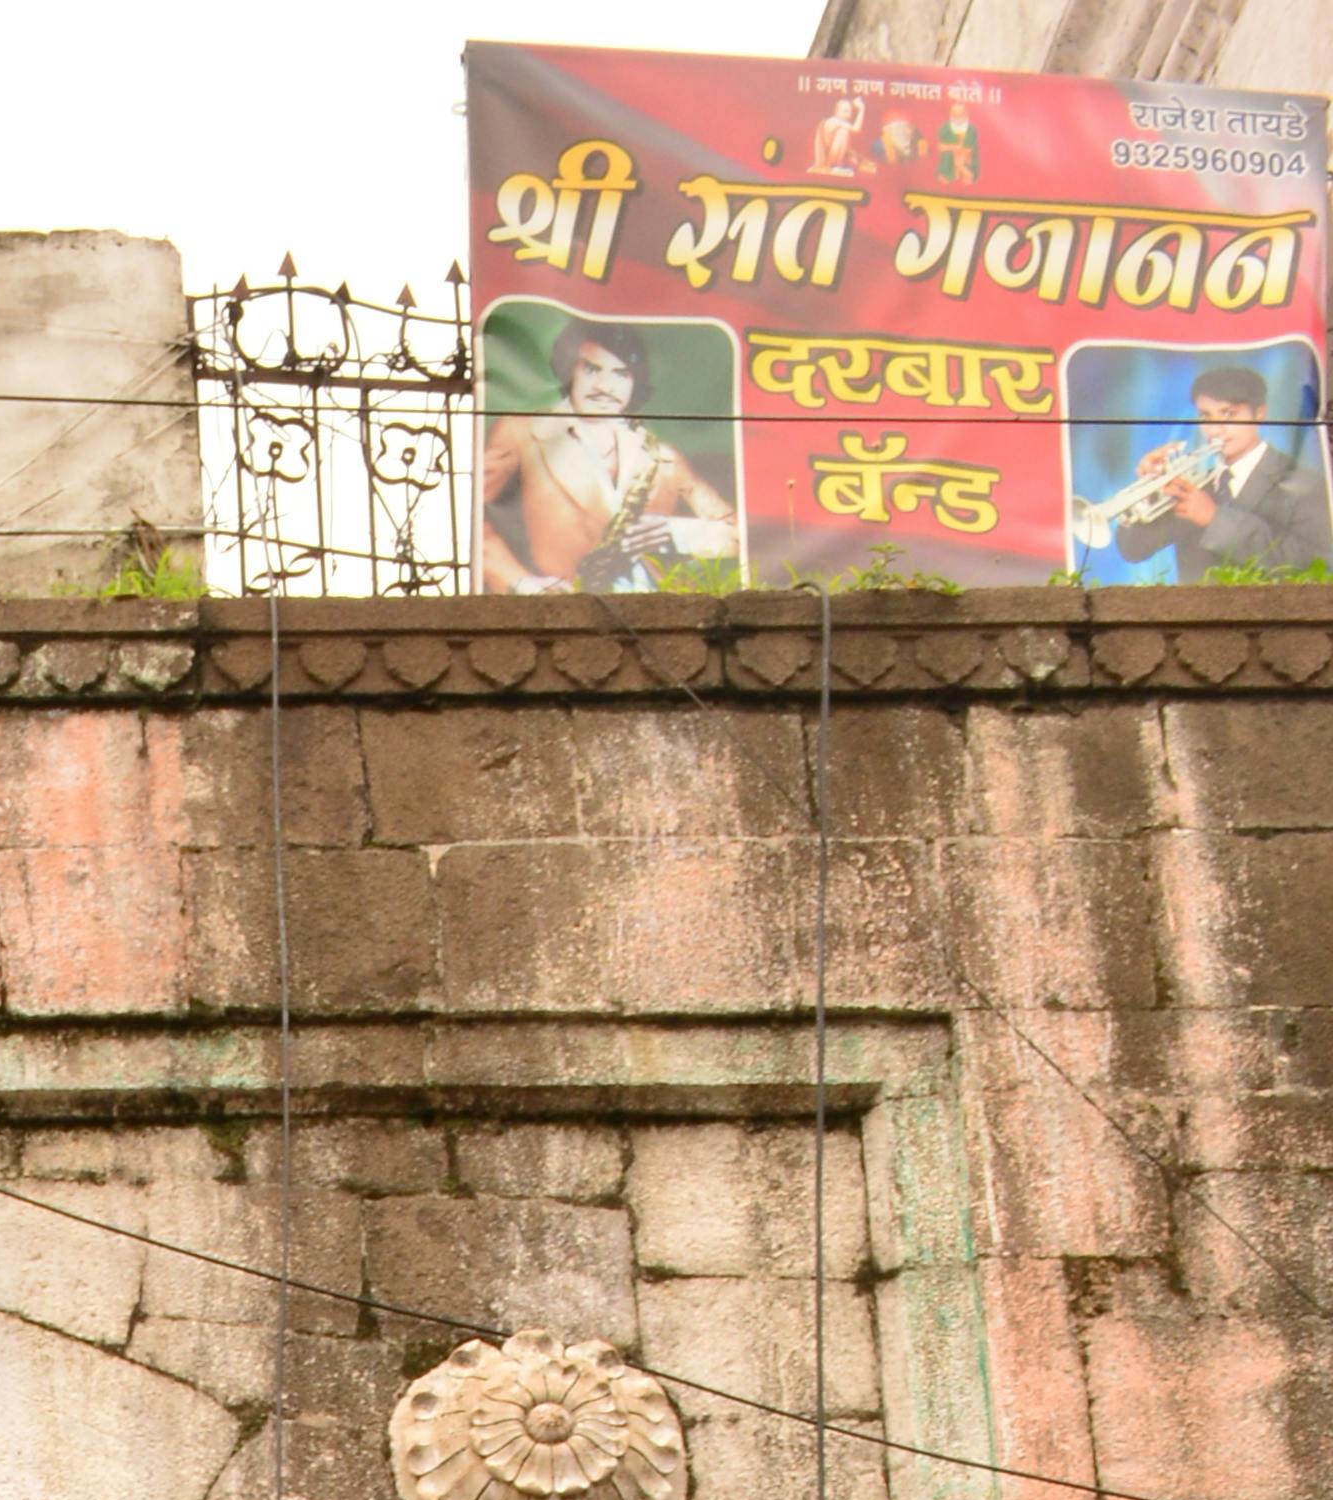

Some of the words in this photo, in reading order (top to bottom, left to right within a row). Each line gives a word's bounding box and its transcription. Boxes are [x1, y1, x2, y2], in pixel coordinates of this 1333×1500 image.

[816, 76, 847, 94] गण
[852, 79, 885, 96] गण
[1132, 97, 1218, 133] राजेश
[1226, 101, 1307, 139] तायडे
[1113, 141, 1307, 177] 9325960904
[486, 139, 638, 281] श्री
[665, 137, 863, 290] संत
[893, 194, 1316, 316] गजानन
[747, 332, 1054, 416] दरबार
[812, 432, 1001, 533] बॅन्ड
